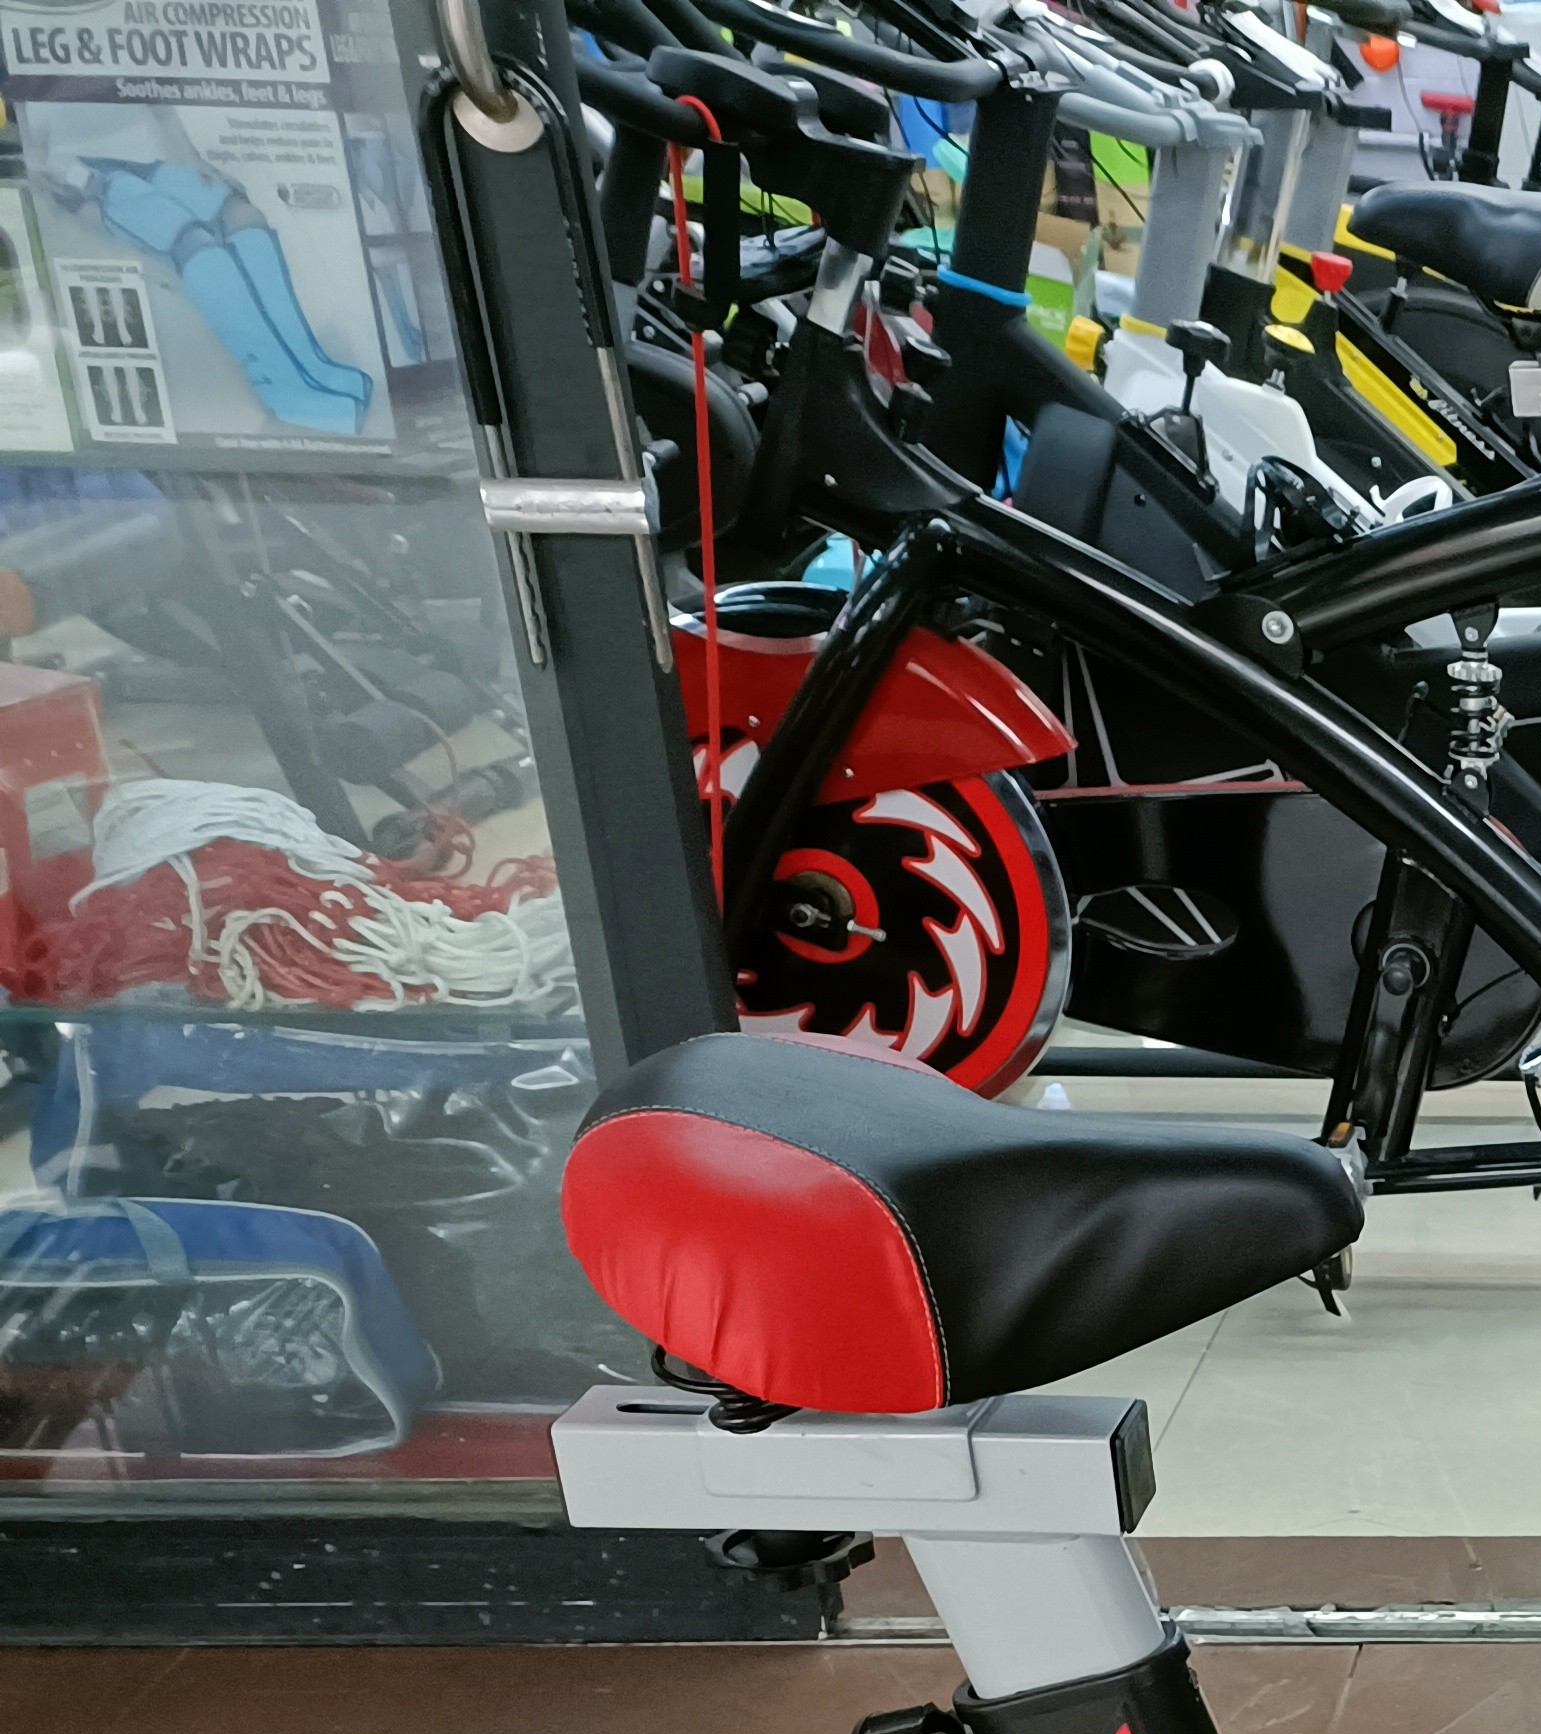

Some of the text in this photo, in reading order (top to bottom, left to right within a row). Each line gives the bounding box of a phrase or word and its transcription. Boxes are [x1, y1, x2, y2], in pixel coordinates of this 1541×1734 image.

[124, 1, 311, 30] AIR COMPRESSION
[11, 27, 71, 64] LEG
[77, 27, 104, 65] &
[107, 28, 188, 67] FOOT
[194, 31, 318, 71] WRAPS
[115, 78, 181, 100] Soothes
